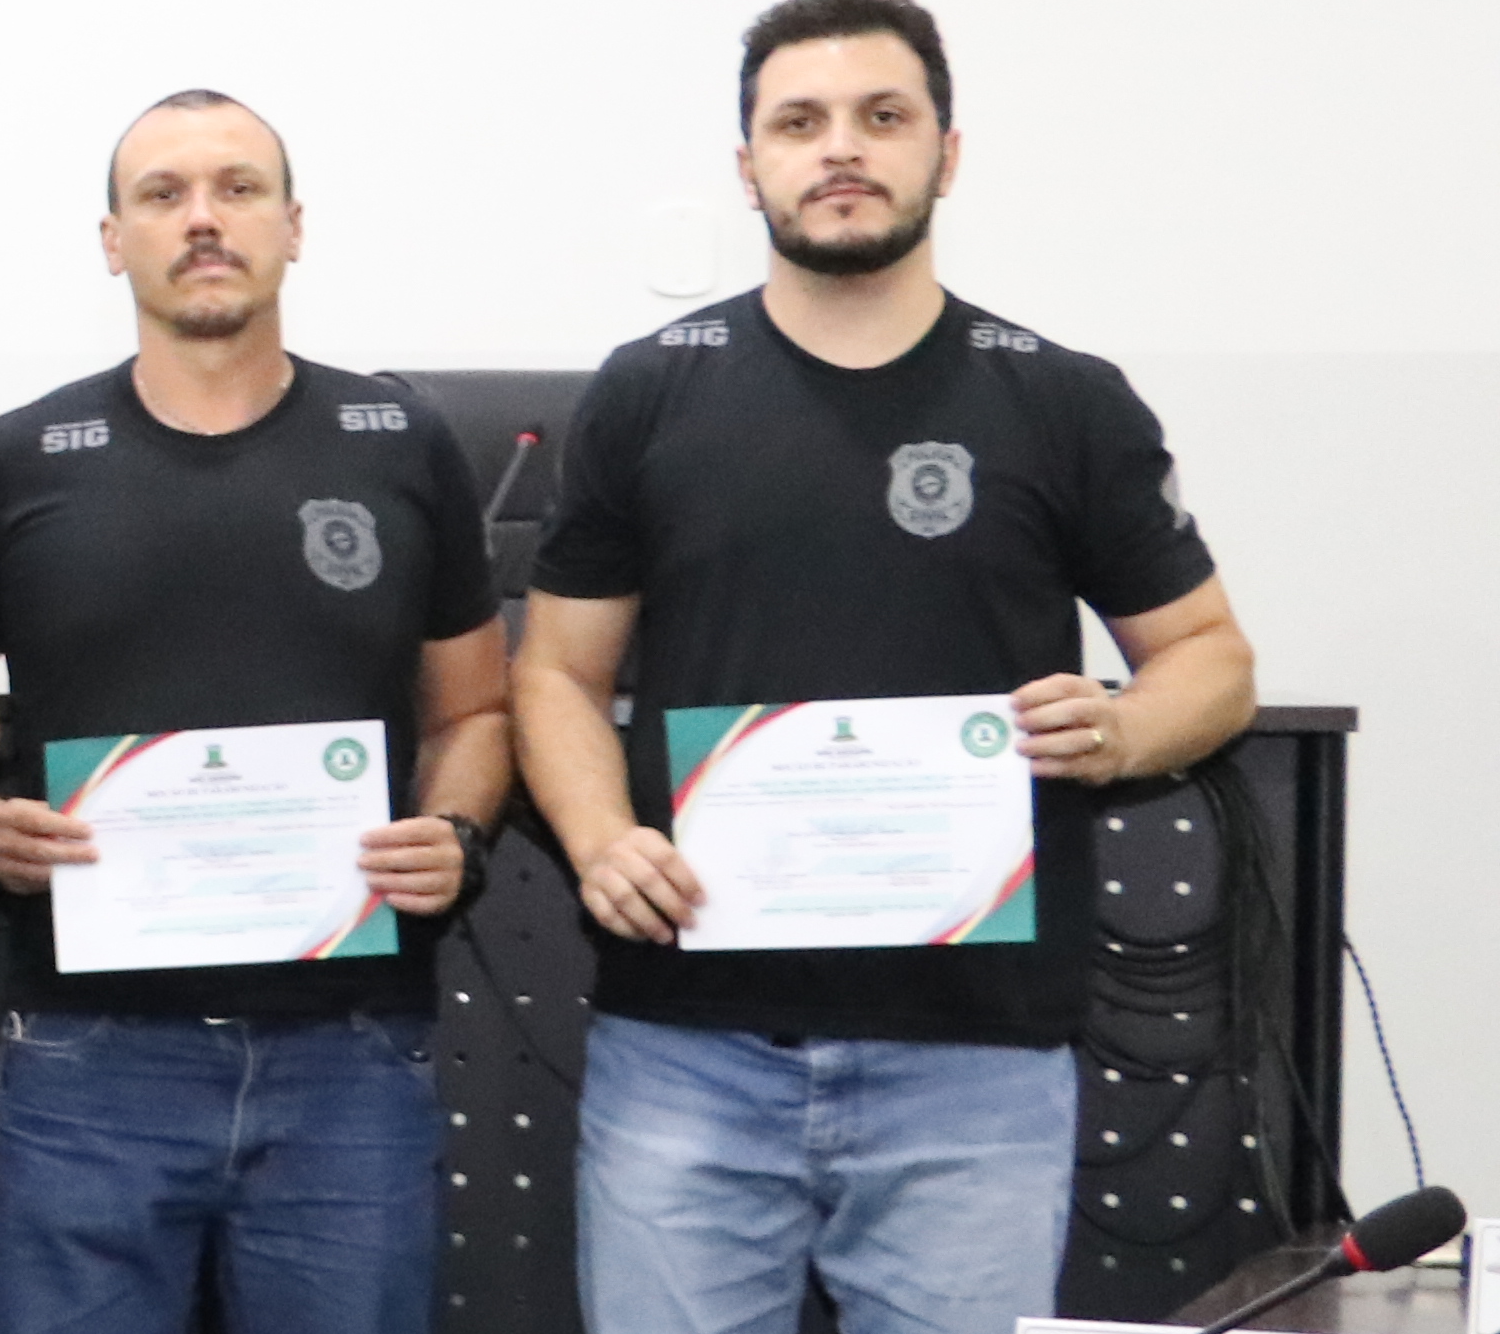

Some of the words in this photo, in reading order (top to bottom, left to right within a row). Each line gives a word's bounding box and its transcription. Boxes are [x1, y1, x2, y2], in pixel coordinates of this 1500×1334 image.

[659, 326, 731, 348] SIG
[338, 409, 408, 432] SIG
[42, 425, 109, 454] SIG
